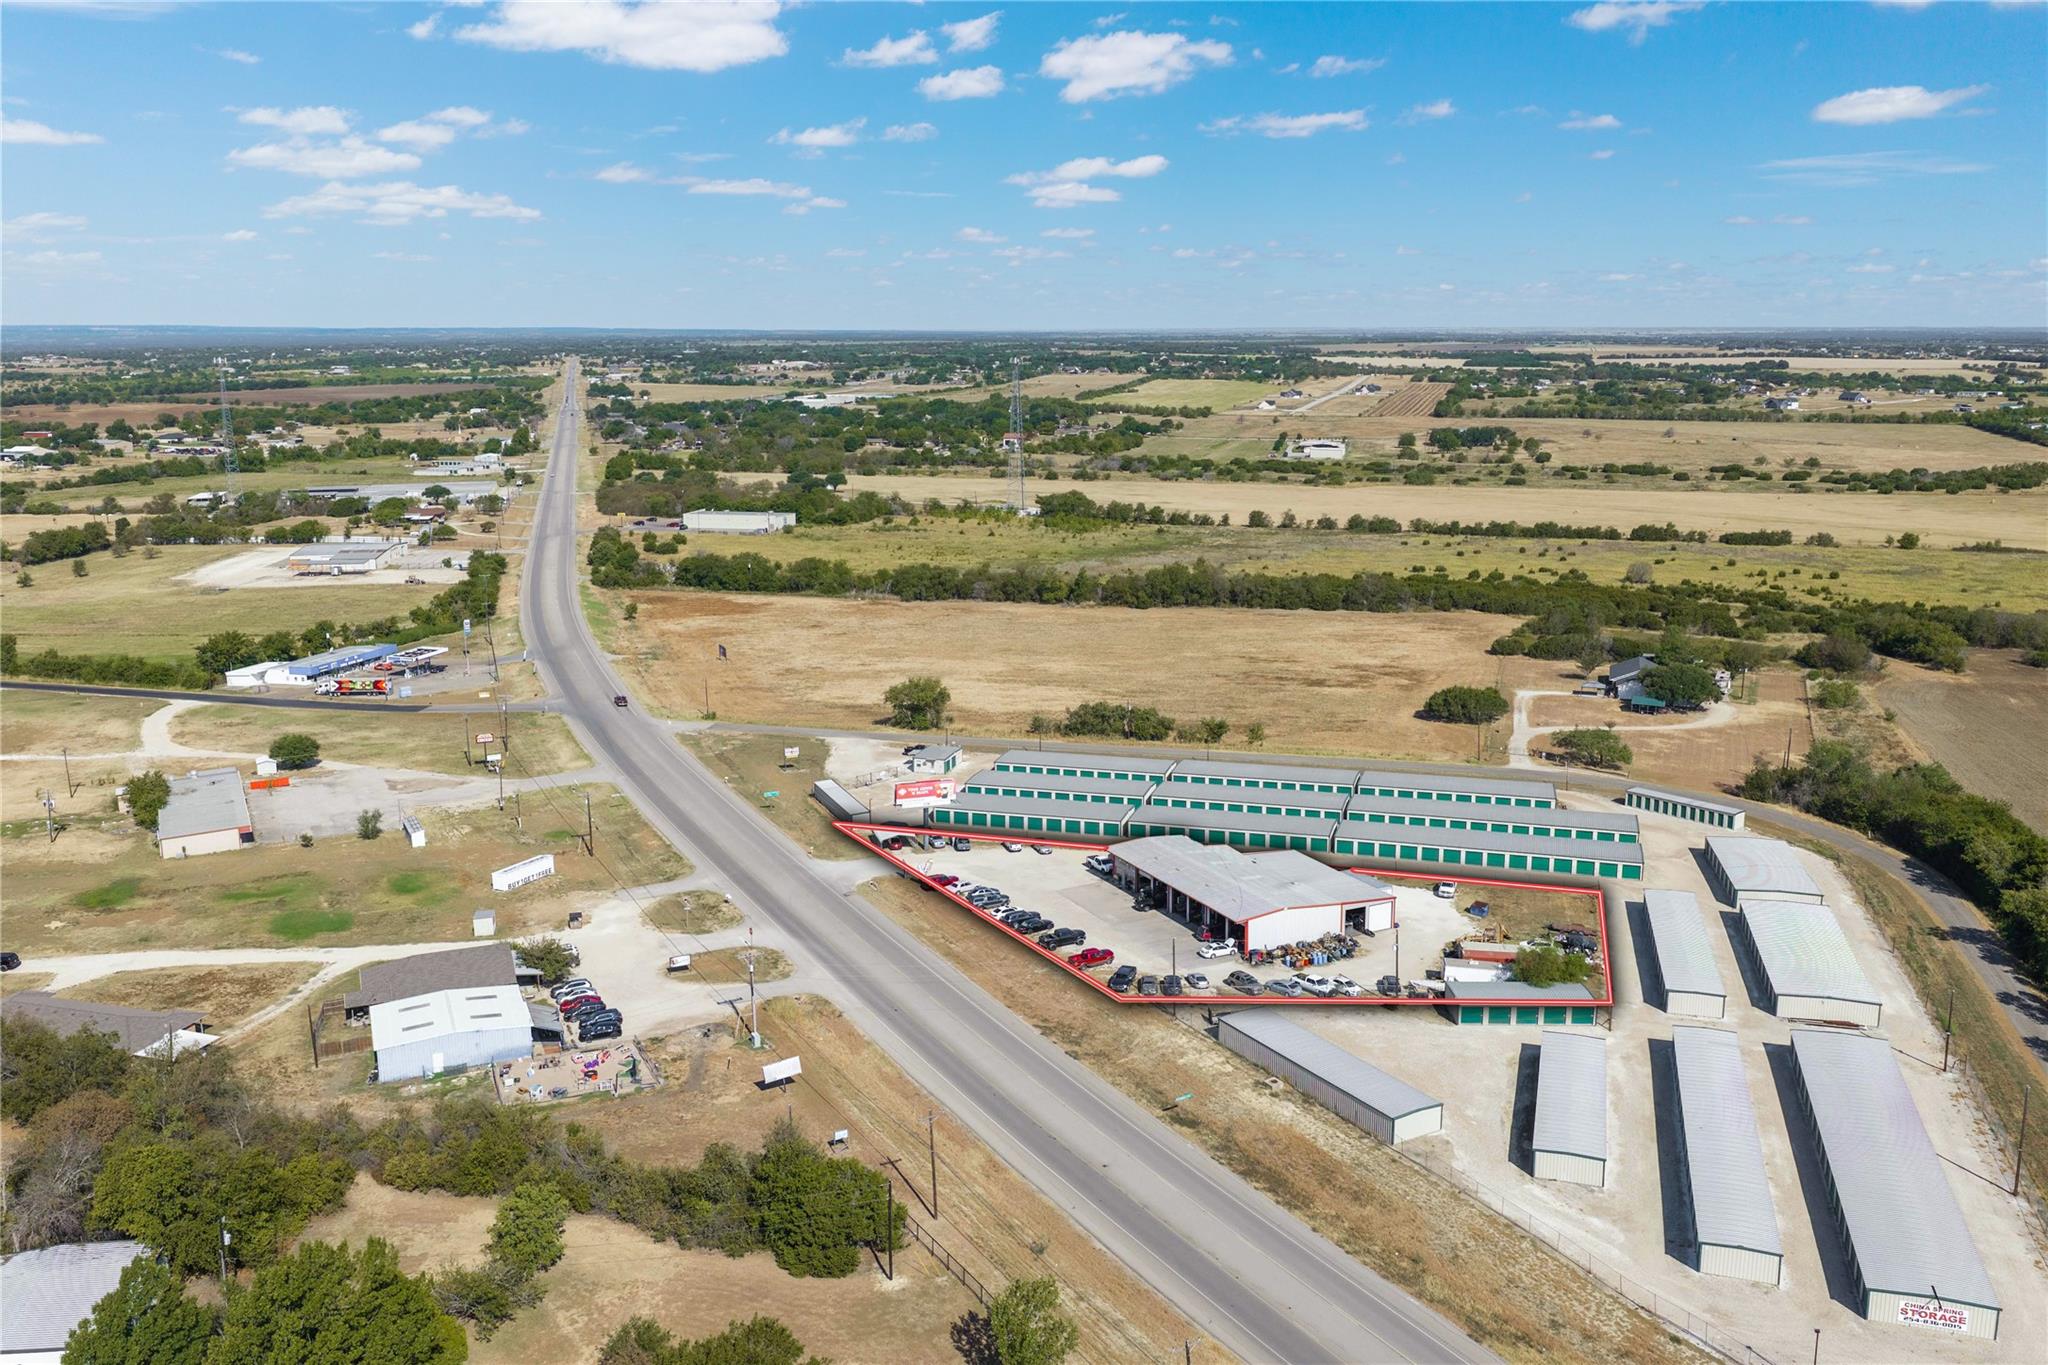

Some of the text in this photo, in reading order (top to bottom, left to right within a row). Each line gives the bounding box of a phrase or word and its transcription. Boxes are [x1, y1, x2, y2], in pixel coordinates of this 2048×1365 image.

[508, 880, 520, 889] BUY
[1900, 1307, 1967, 1325] STORAGE
[1904, 1302, 1964, 1316] CHINA SPRING
